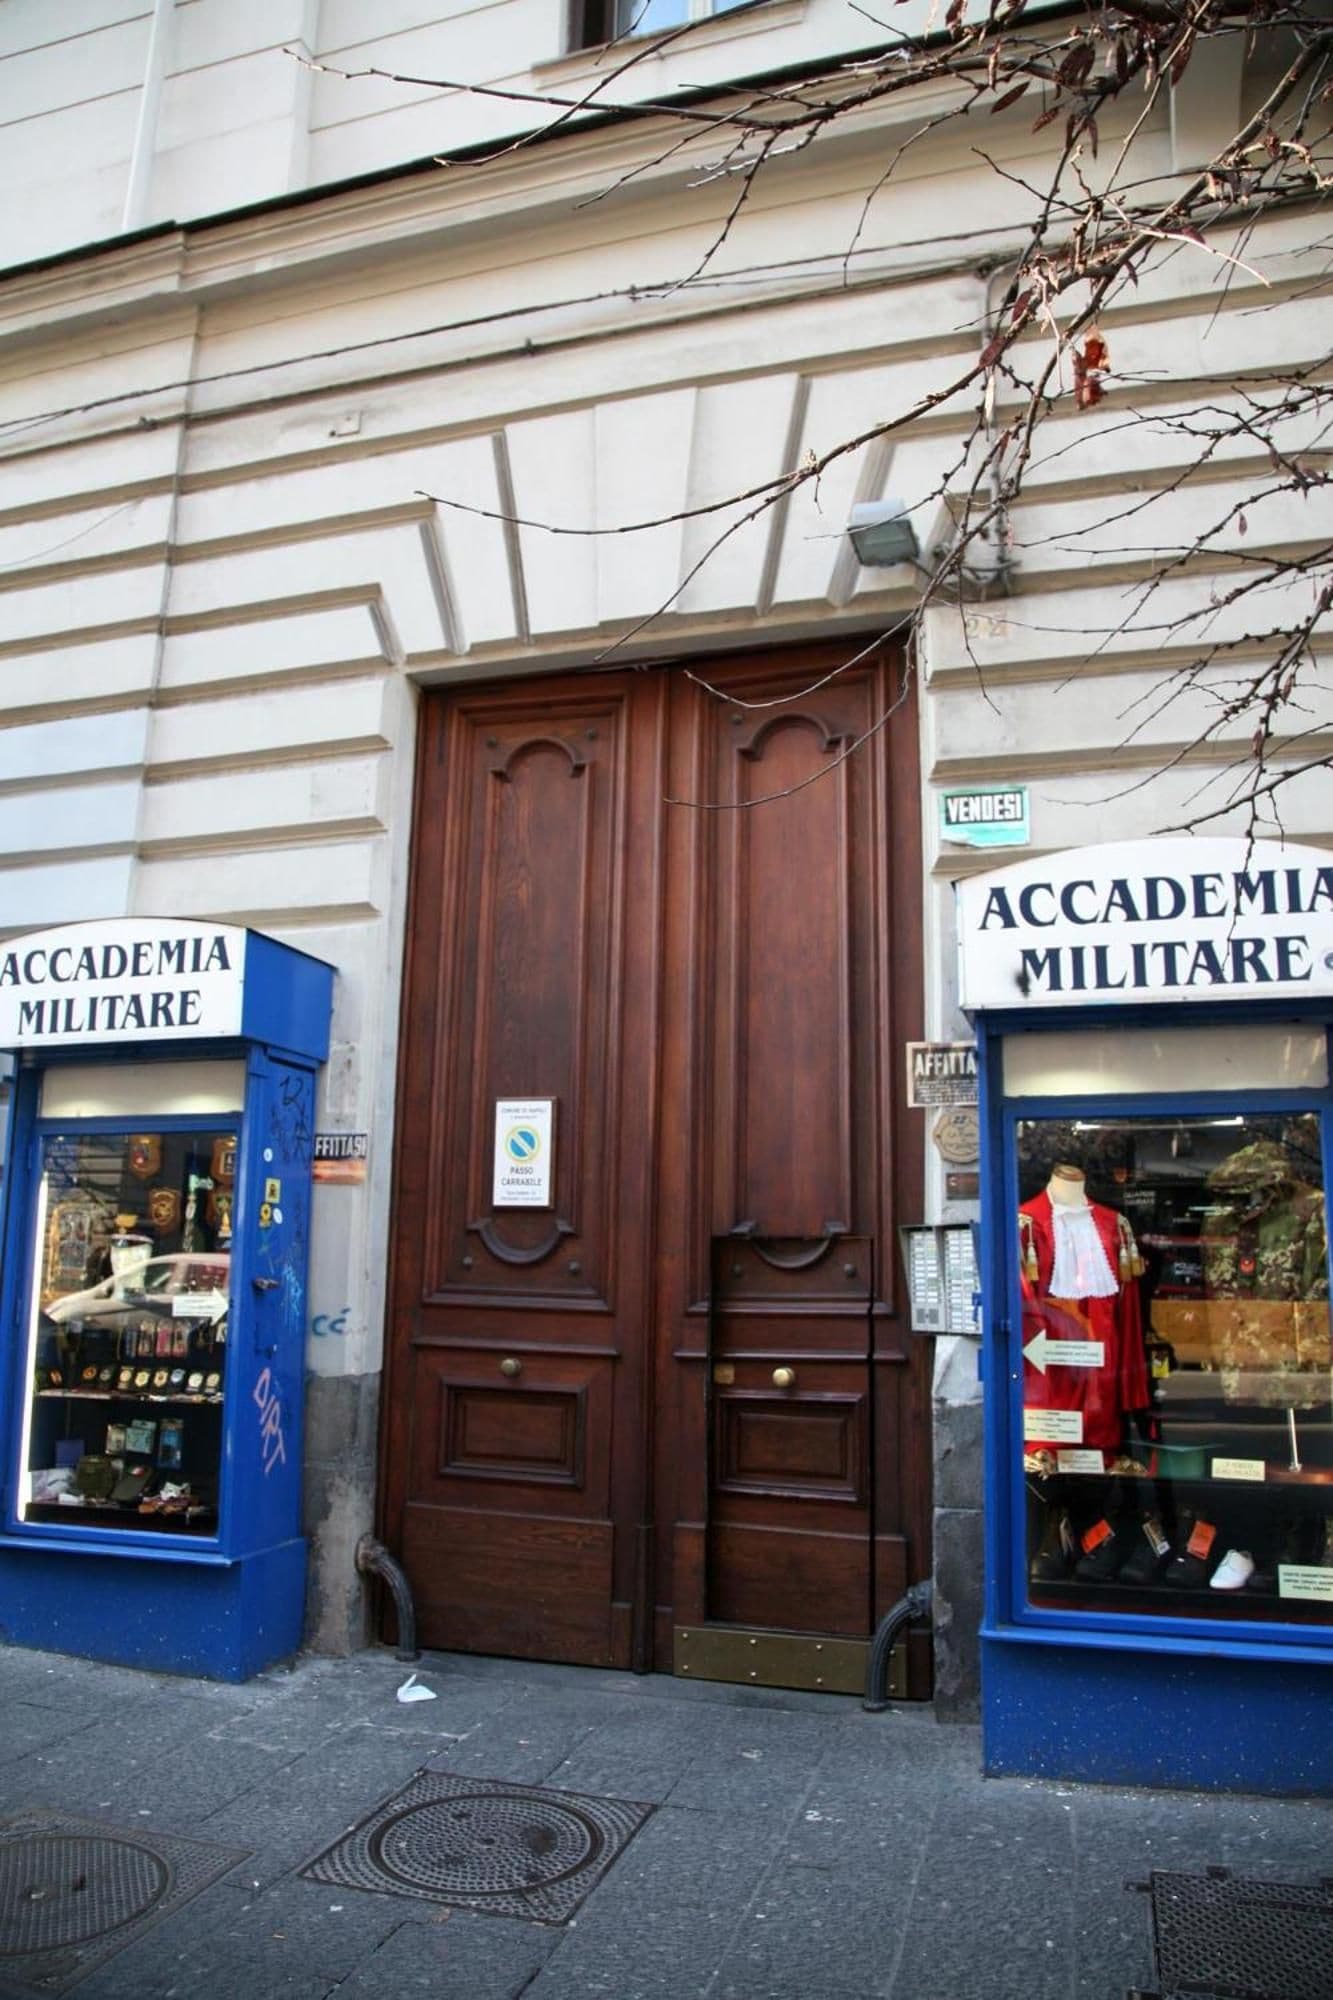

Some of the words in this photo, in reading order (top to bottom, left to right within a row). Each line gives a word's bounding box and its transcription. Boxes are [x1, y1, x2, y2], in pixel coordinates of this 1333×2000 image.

[947, 793, 1021, 822] VENDESI
[978, 867, 1333, 930] ACCADEMIA
[0, 936, 231, 986] ACCADEMIA
[1021, 936, 1313, 991] MILITARE
[18, 990, 202, 1035] MILITARE
[511, 1166, 534, 1175] PASSO
